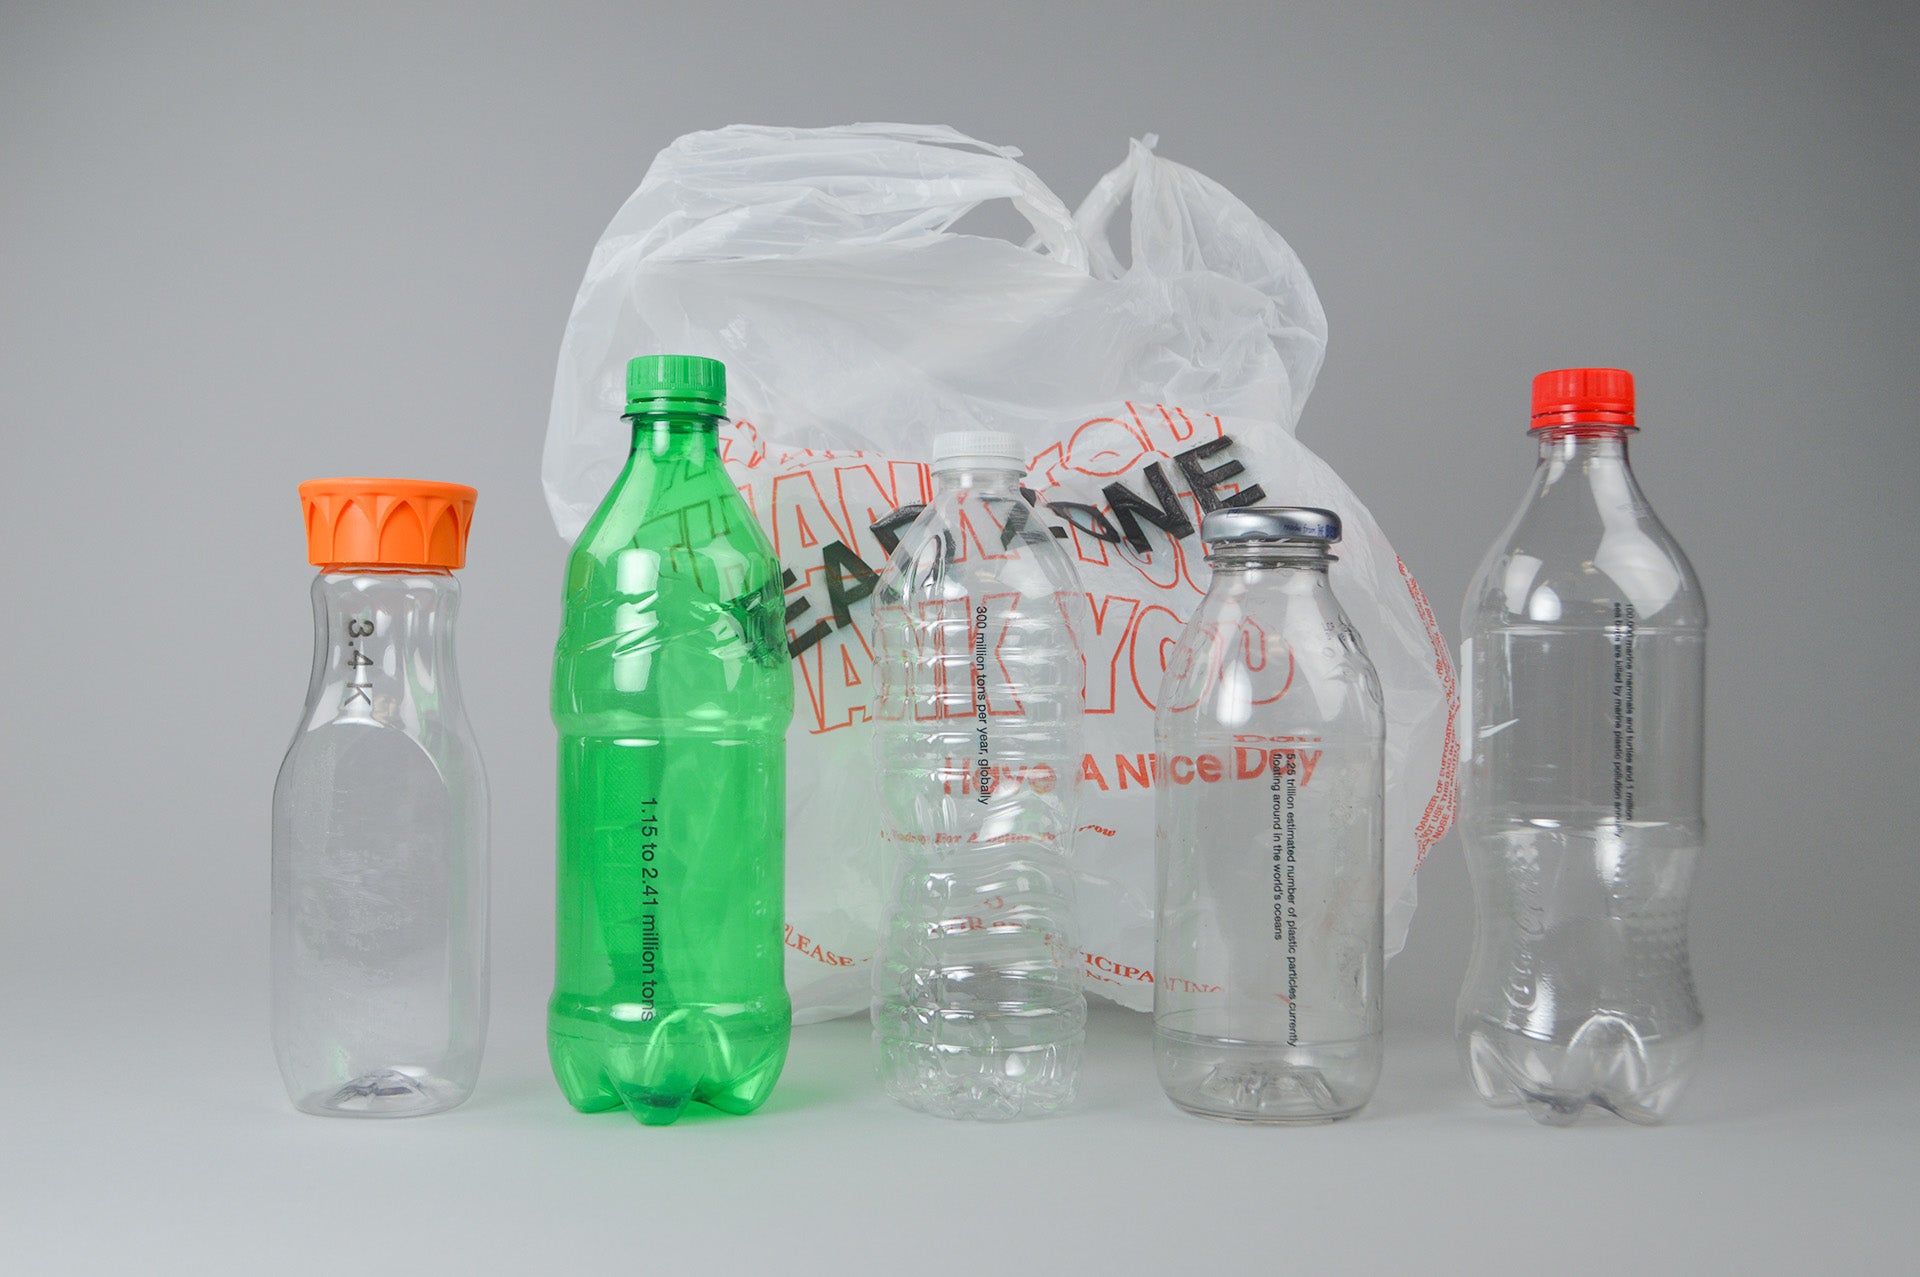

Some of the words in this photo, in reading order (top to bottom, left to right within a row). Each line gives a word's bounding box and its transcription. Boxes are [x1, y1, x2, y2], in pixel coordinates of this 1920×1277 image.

[976, 606, 987, 629] 300
[347, 619, 375, 671] 3.4
[976, 632, 987, 671] million
[1614, 644, 1622, 658] are
[1625, 640, 1634, 670] marine
[1614, 661, 1623, 683] killed
[976, 674, 988, 701] tons
[1613, 686, 1623, 697] by
[1625, 672, 1634, 715] mammals
[973, 704, 989, 725] per
[1614, 699, 1623, 728] marine
[1625, 717, 1634, 733] and
[976, 727, 989, 756] year,
[1613, 731, 1623, 759] plastic
[944, 757, 1057, 796] Have
[1080, 753, 1110, 791] A
[1115, 752, 1223, 790] Nice
[1234, 745, 1324, 788] Day
[1271, 753, 1283, 791] floating
[1287, 753, 1297, 776] 5.25
[1625, 765, 1634, 782] and
[976, 758, 991, 806] globally
[1287, 778, 1297, 809] trillion
[1613, 762, 1623, 799] pollution
[641, 797, 659, 838] 1.15
[1273, 794, 1282, 830] around
[1414, 795, 1439, 832] DANGER
[1430, 805, 1444, 823] USE
[1625, 792, 1634, 821] million
[935, 832, 962, 844] For
[1273, 832, 1282, 842] in
[1287, 812, 1297, 862] estimated
[1432, 813, 1450, 839] NOSE
[641, 842, 659, 862] to
[1273, 844, 1282, 861] the
[641, 867, 659, 907] 2.41
[1273, 864, 1283, 900] world's
[1287, 865, 1297, 905] number
[1273, 903, 1282, 941] oceans
[1287, 907, 1297, 918] of
[641, 914, 659, 974] million
[1286, 920, 1298, 954] plastic
[1286, 956, 1298, 1000] particles
[641, 980, 659, 1023] tons
[1286, 1002, 1299, 1047] currently
